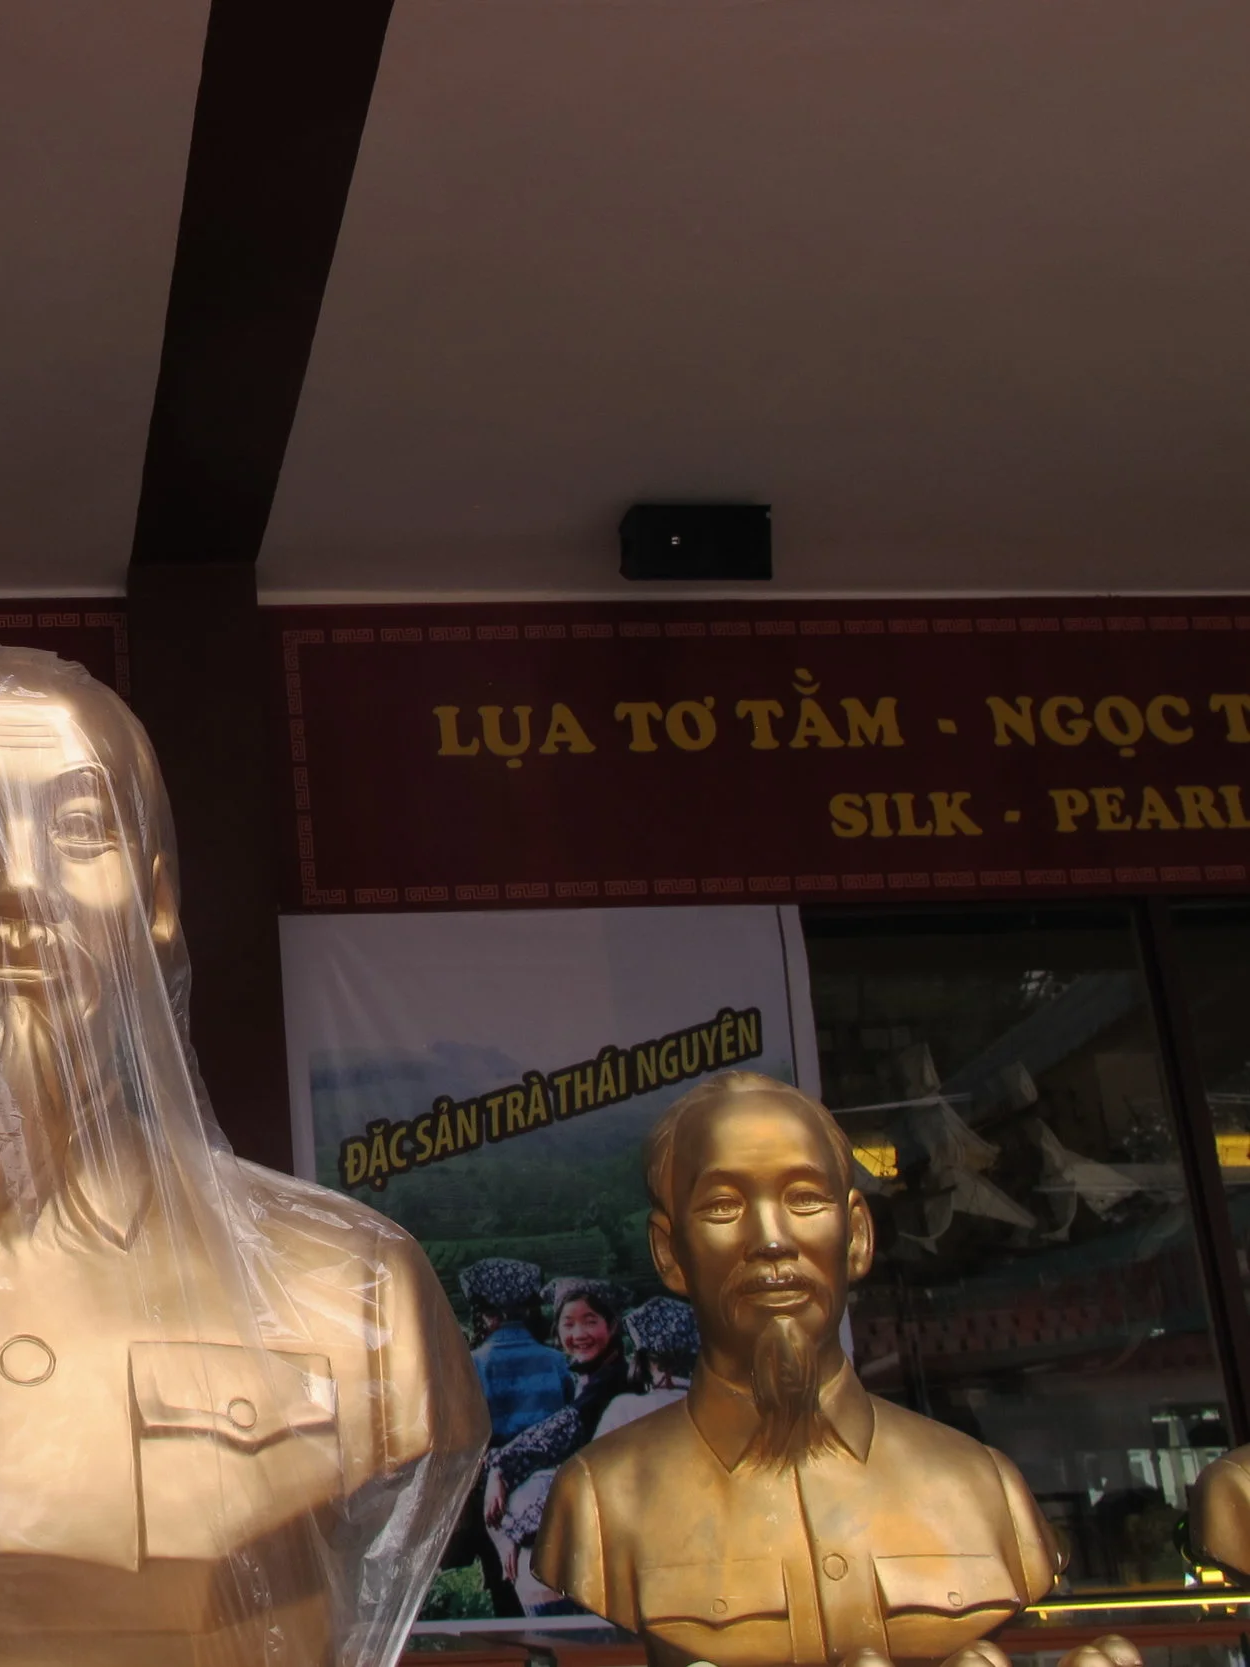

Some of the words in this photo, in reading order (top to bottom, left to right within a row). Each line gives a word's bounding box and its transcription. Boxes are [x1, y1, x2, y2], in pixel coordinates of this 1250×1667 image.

[433, 702, 597, 769] LỤA
[614, 695, 717, 753] TƠ
[735, 667, 904, 750] TẰM
[985, 694, 1195, 758] NGỌC
[828, 791, 983, 838] SILK
[1048, 784, 1250, 833] PEARL
[344, 1123, 408, 1187] ĐẶC
[415, 1101, 479, 1162] SẢN
[485, 1071, 548, 1137] TRÀ
[553, 1051, 626, 1115] THÁI
[635, 1012, 759, 1090] NGUYÊN
